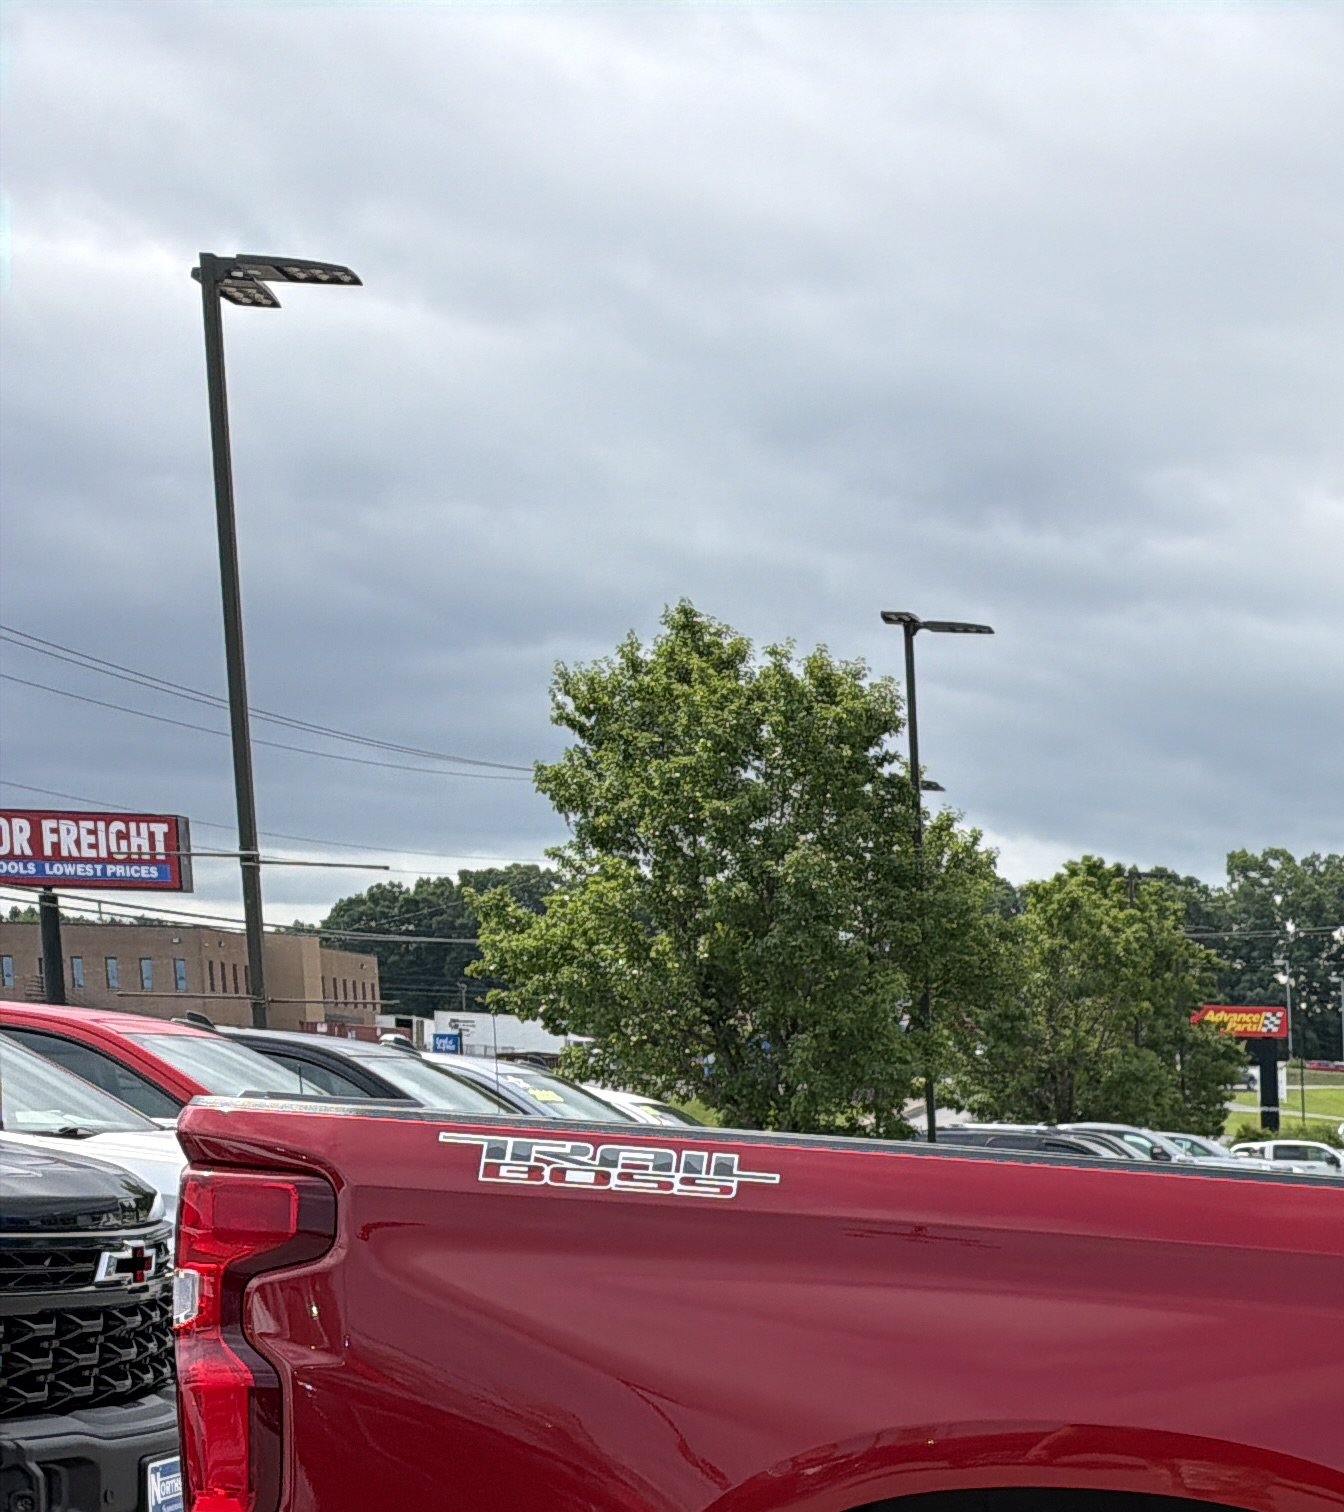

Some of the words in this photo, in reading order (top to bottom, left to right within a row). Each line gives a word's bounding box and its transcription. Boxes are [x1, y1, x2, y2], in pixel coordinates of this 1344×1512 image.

[41, 819, 169, 860] FREIGHT
[45, 864, 103, 877] LOWEST
[106, 865, 159, 878] PRICES
[1204, 1010, 1261, 1024] Advance
[438, 1131, 781, 1184] TRAIL
[478, 1161, 739, 1199] BOSS
